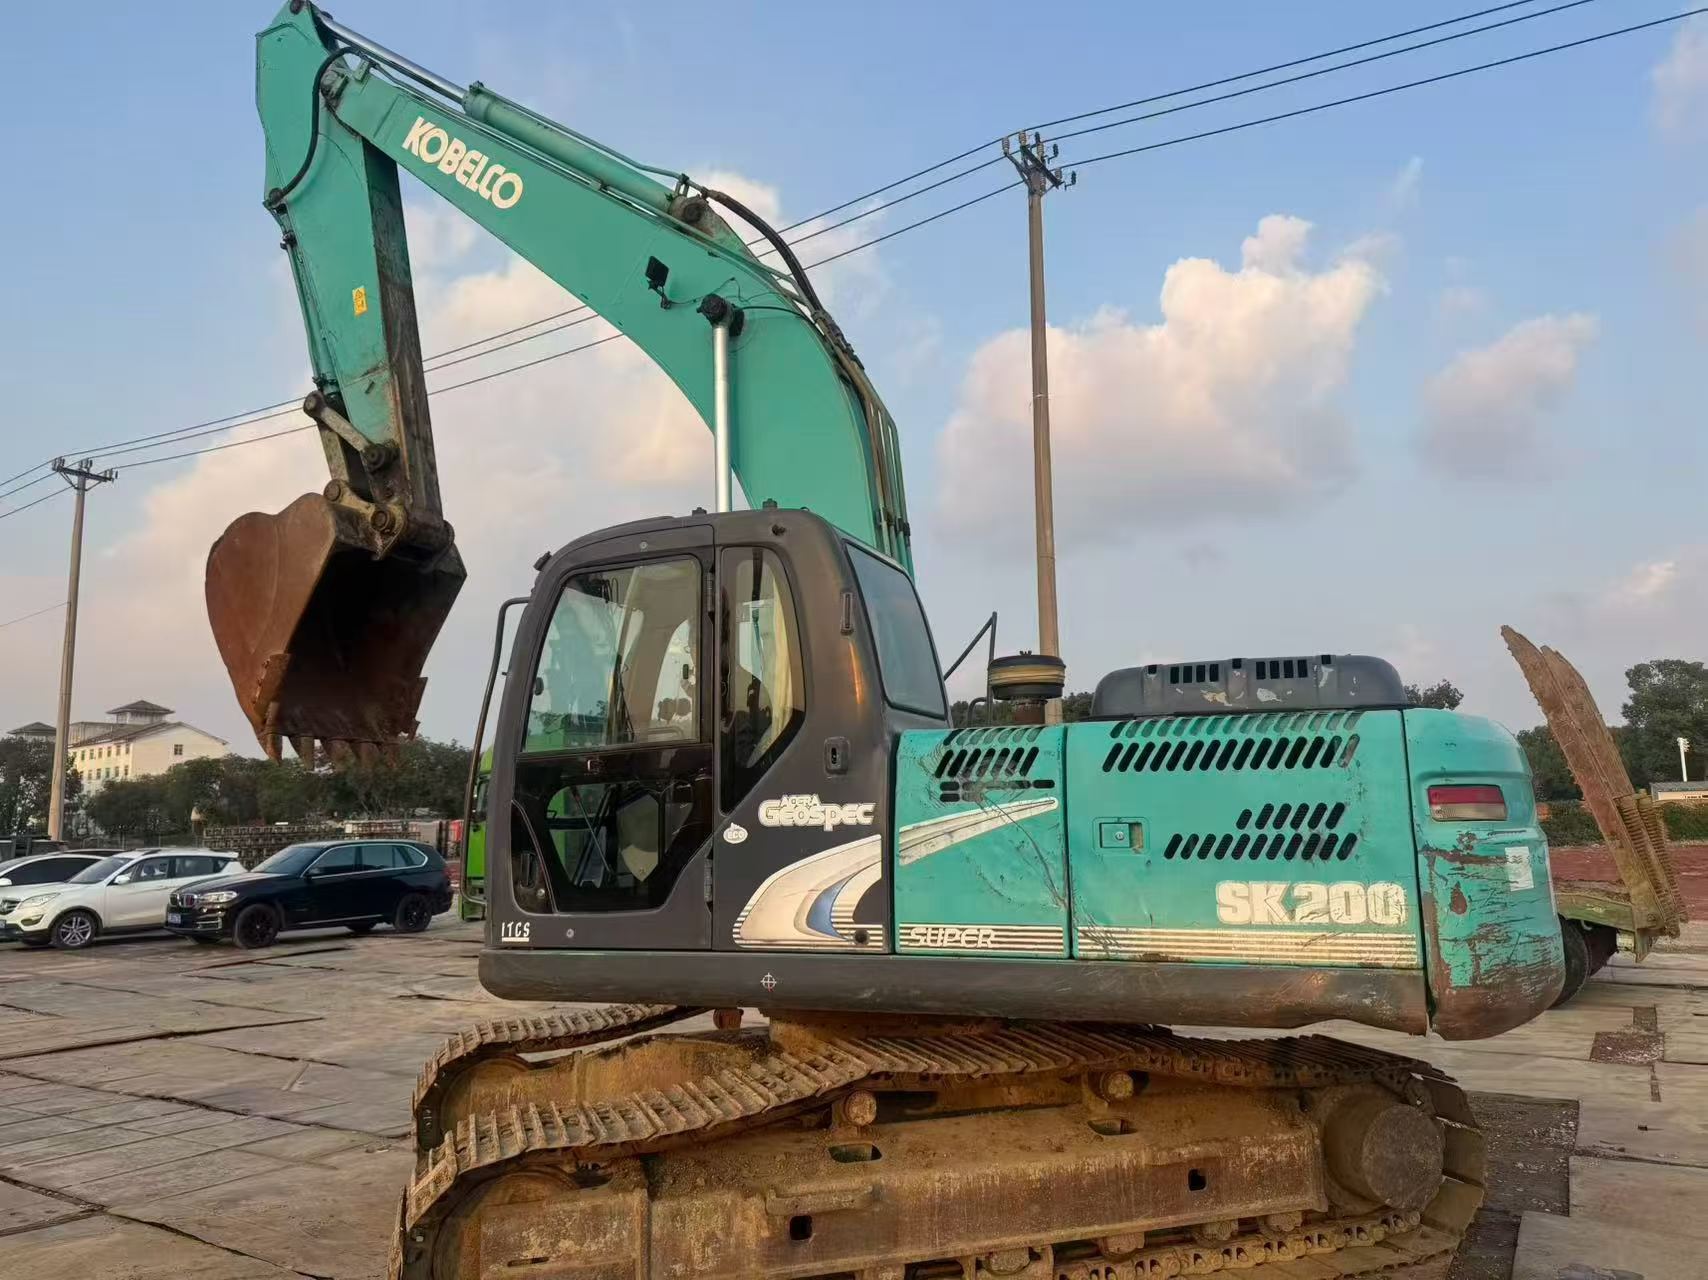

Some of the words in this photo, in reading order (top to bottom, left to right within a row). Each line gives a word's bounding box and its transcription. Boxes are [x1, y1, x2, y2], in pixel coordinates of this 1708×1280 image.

[402, 116, 524, 209] KOBELCO
[727, 831, 745, 840] ECO
[1217, 880, 1408, 925] SK200
[502, 921, 530, 937] ITCS
[909, 927, 996, 948] SUPER
